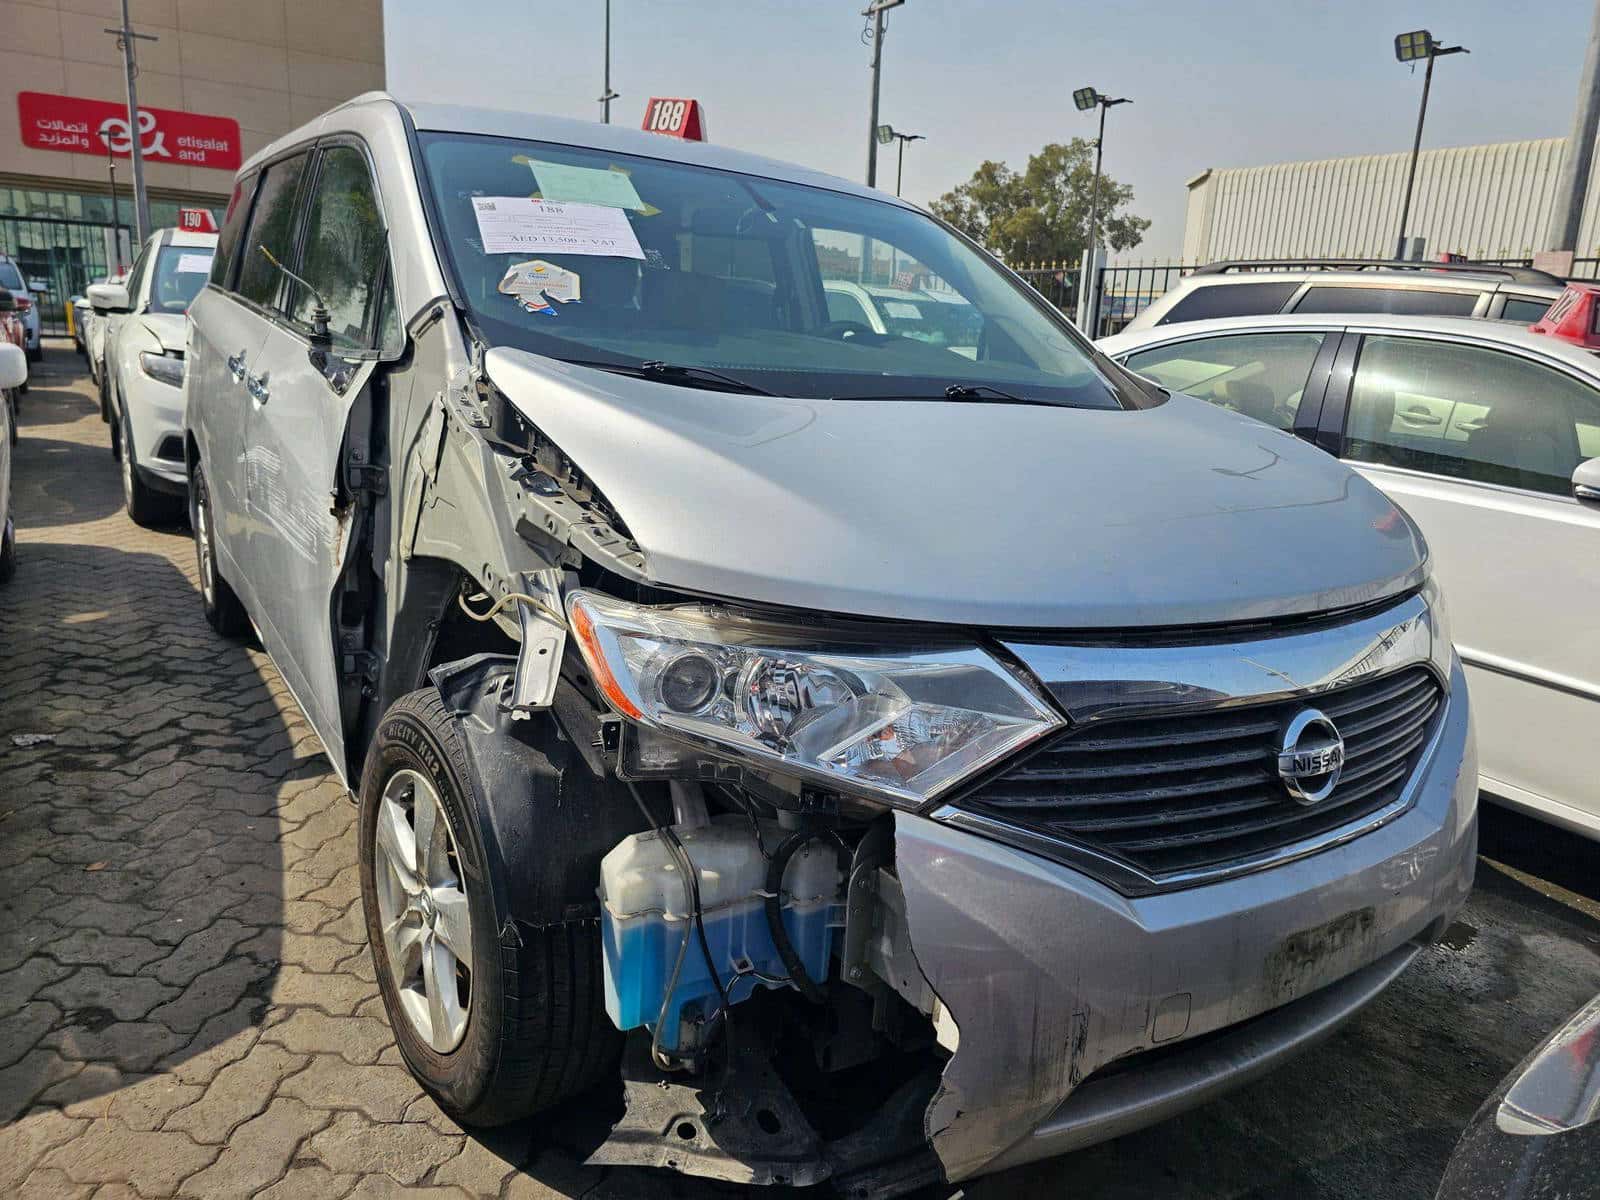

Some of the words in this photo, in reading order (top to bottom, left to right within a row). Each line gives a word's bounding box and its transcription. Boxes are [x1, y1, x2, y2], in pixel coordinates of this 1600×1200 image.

[651, 101, 685, 131] 188
[177, 136, 228, 152] etisalat
[178, 149, 205, 161] and
[184, 212, 201, 227] 190
